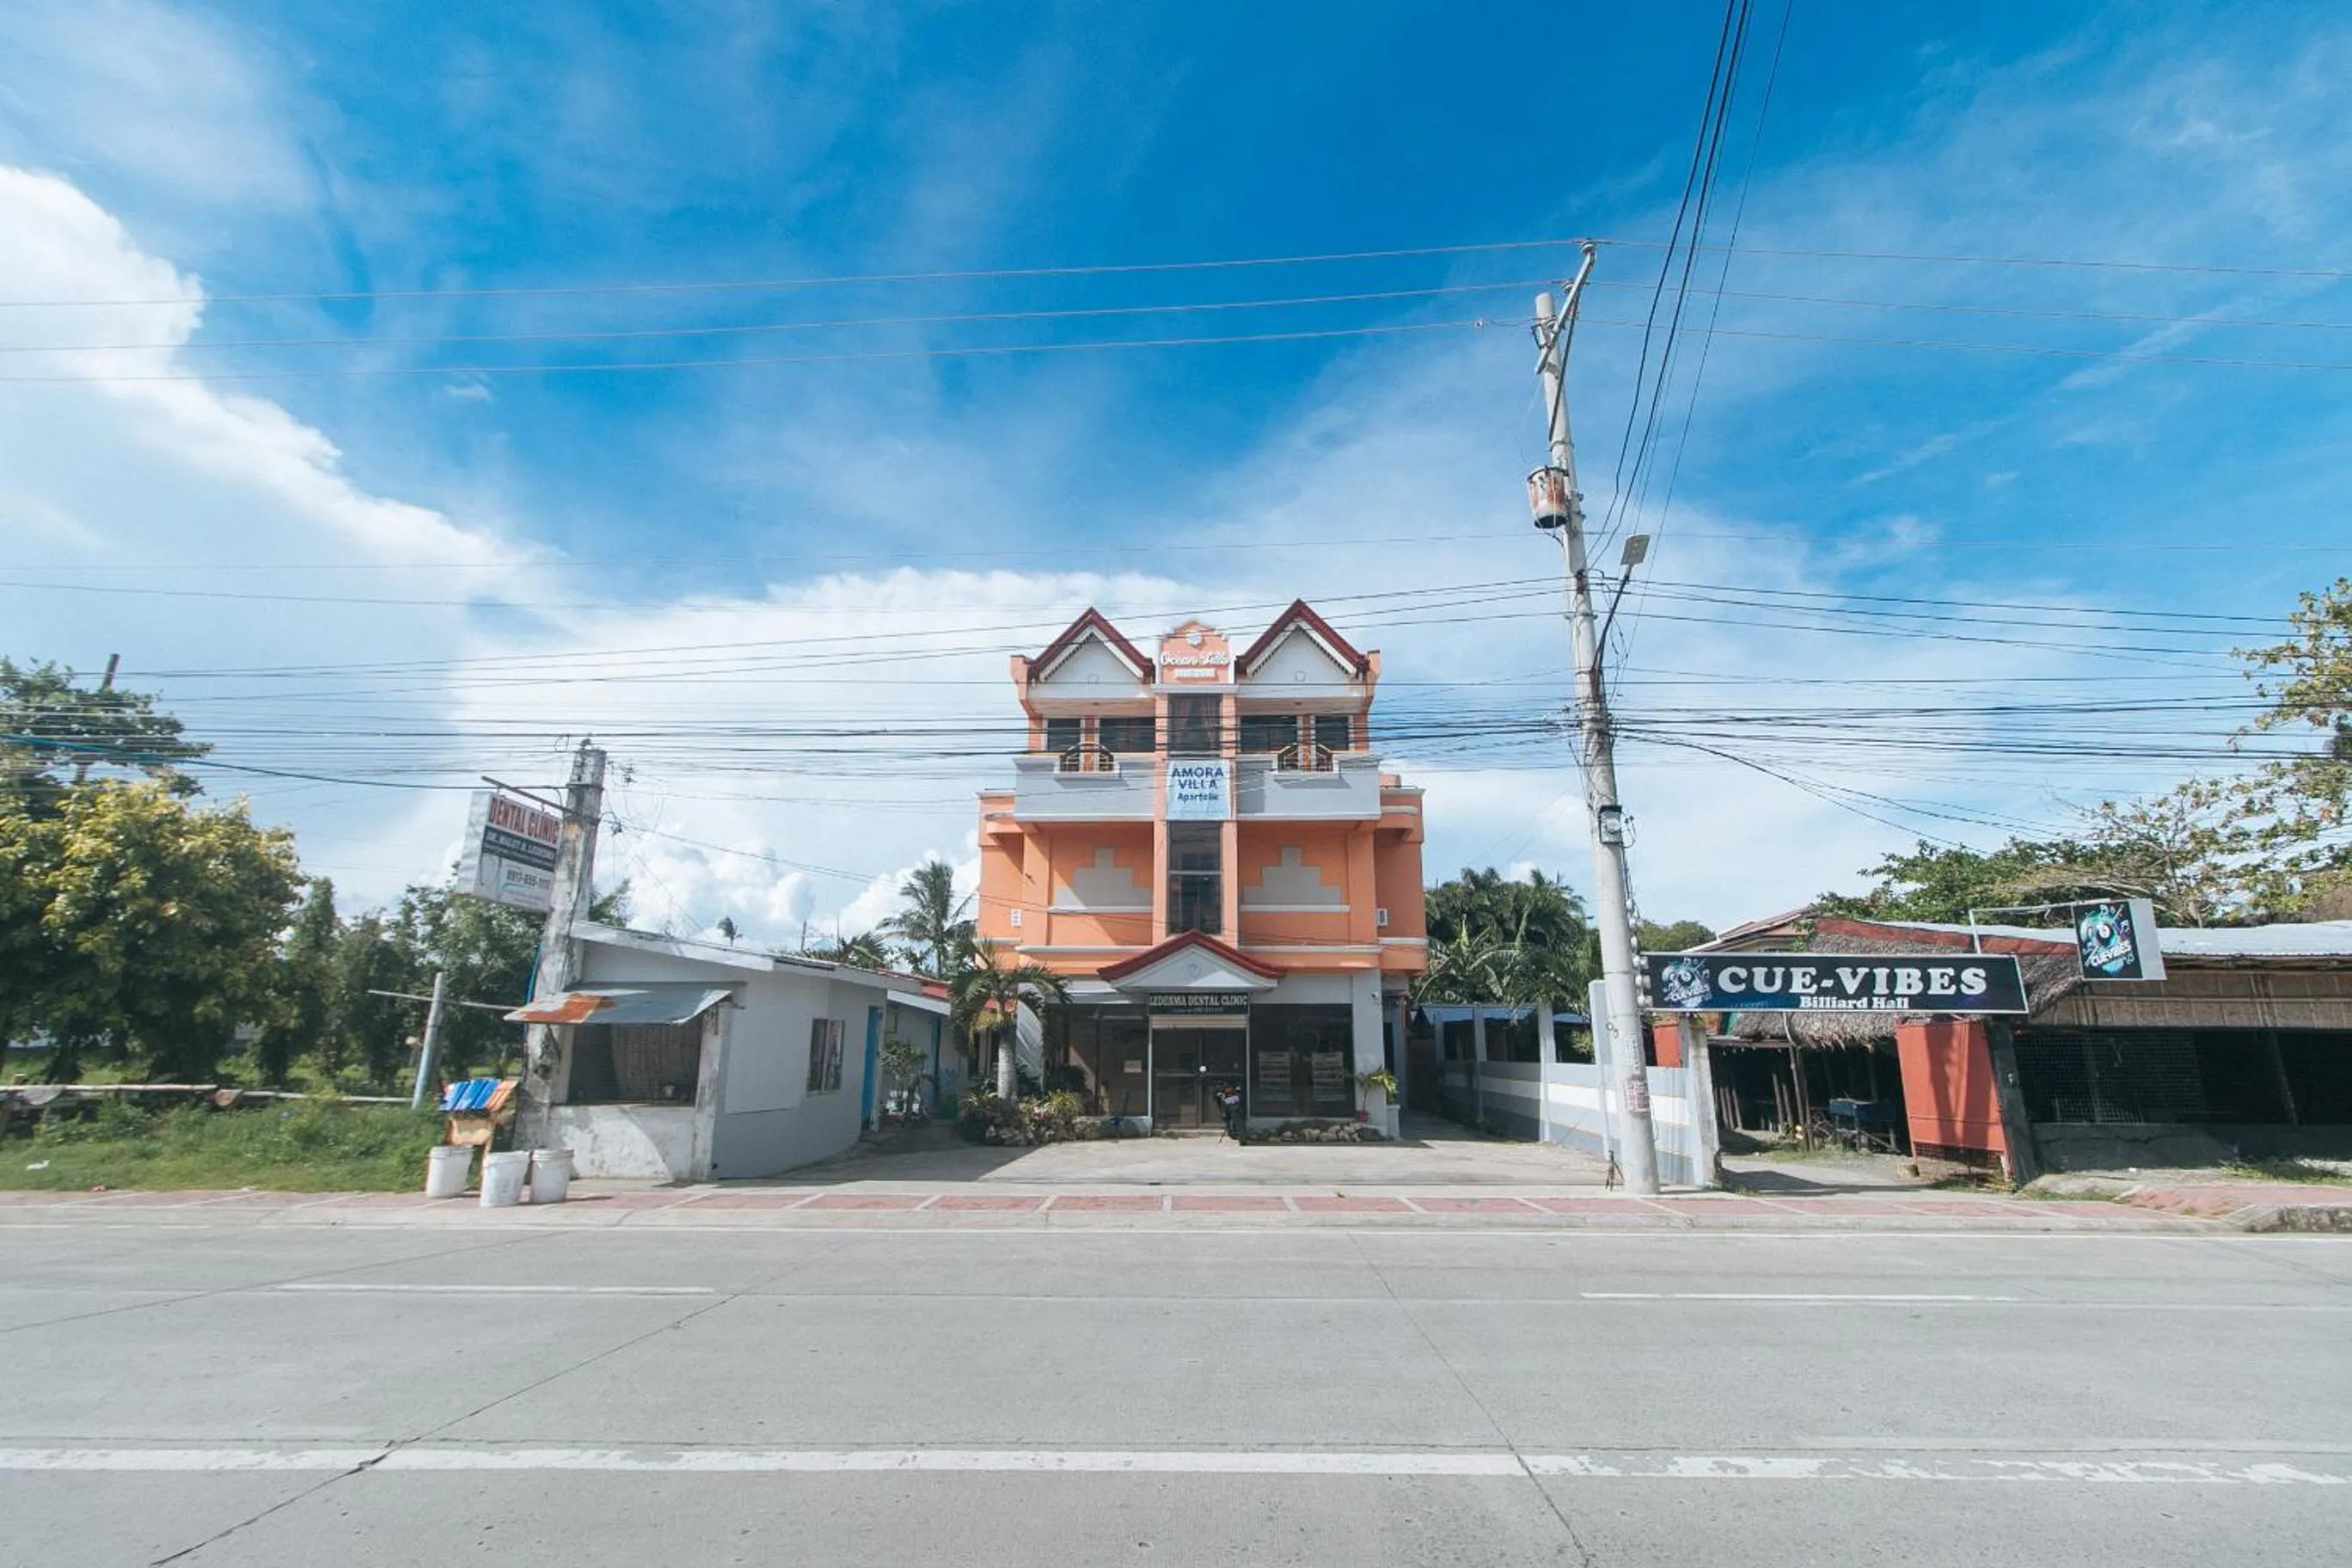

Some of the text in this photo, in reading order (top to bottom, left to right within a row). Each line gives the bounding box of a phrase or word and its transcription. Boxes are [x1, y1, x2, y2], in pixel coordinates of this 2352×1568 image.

[1172, 767, 1224, 778] AMORA
[1179, 779, 1218, 789] VILLA
[489, 797, 559, 844] DENTAL CLINIC
[1718, 966, 1987, 995] CUE-VIBES
[1188, 995, 1220, 1006] DENTAL
[1221, 995, 1248, 1006] CLINIC
[1799, 996, 1909, 1008] Billiard Hall
